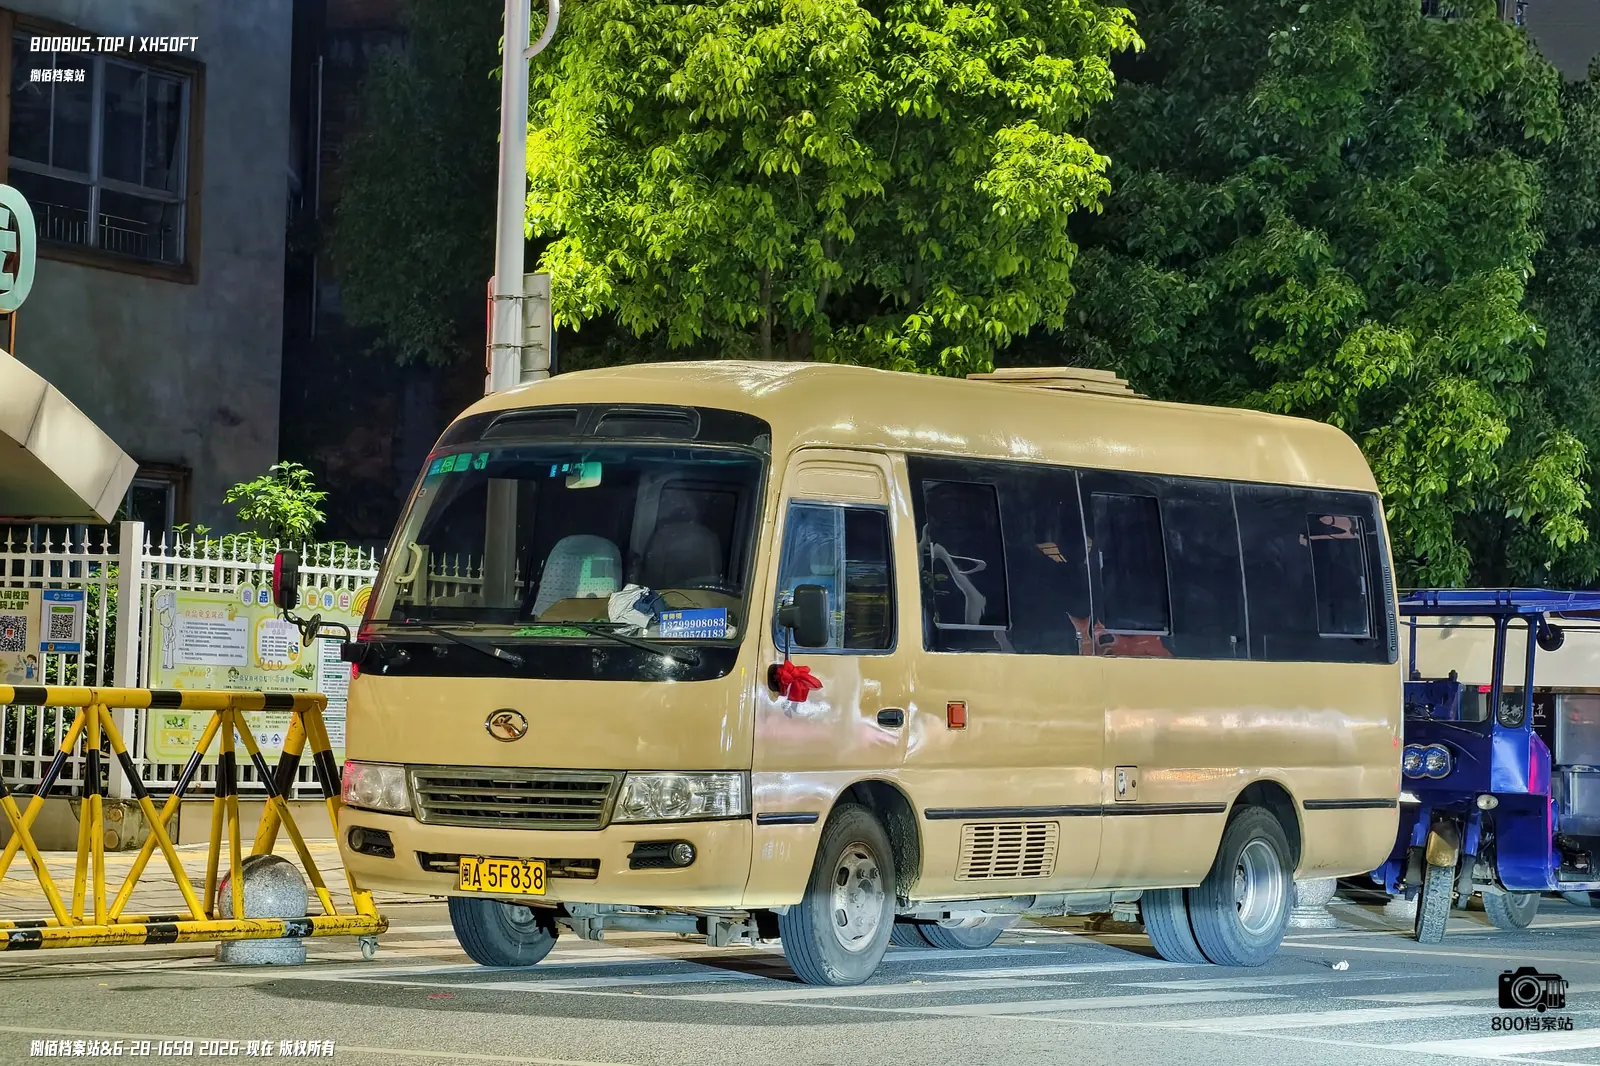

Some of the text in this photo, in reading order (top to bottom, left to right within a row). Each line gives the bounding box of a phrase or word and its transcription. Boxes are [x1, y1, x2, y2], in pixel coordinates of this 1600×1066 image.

[243, 589, 349, 608] 食品宣传栏
[662, 618, 724, 630] 13799908083
